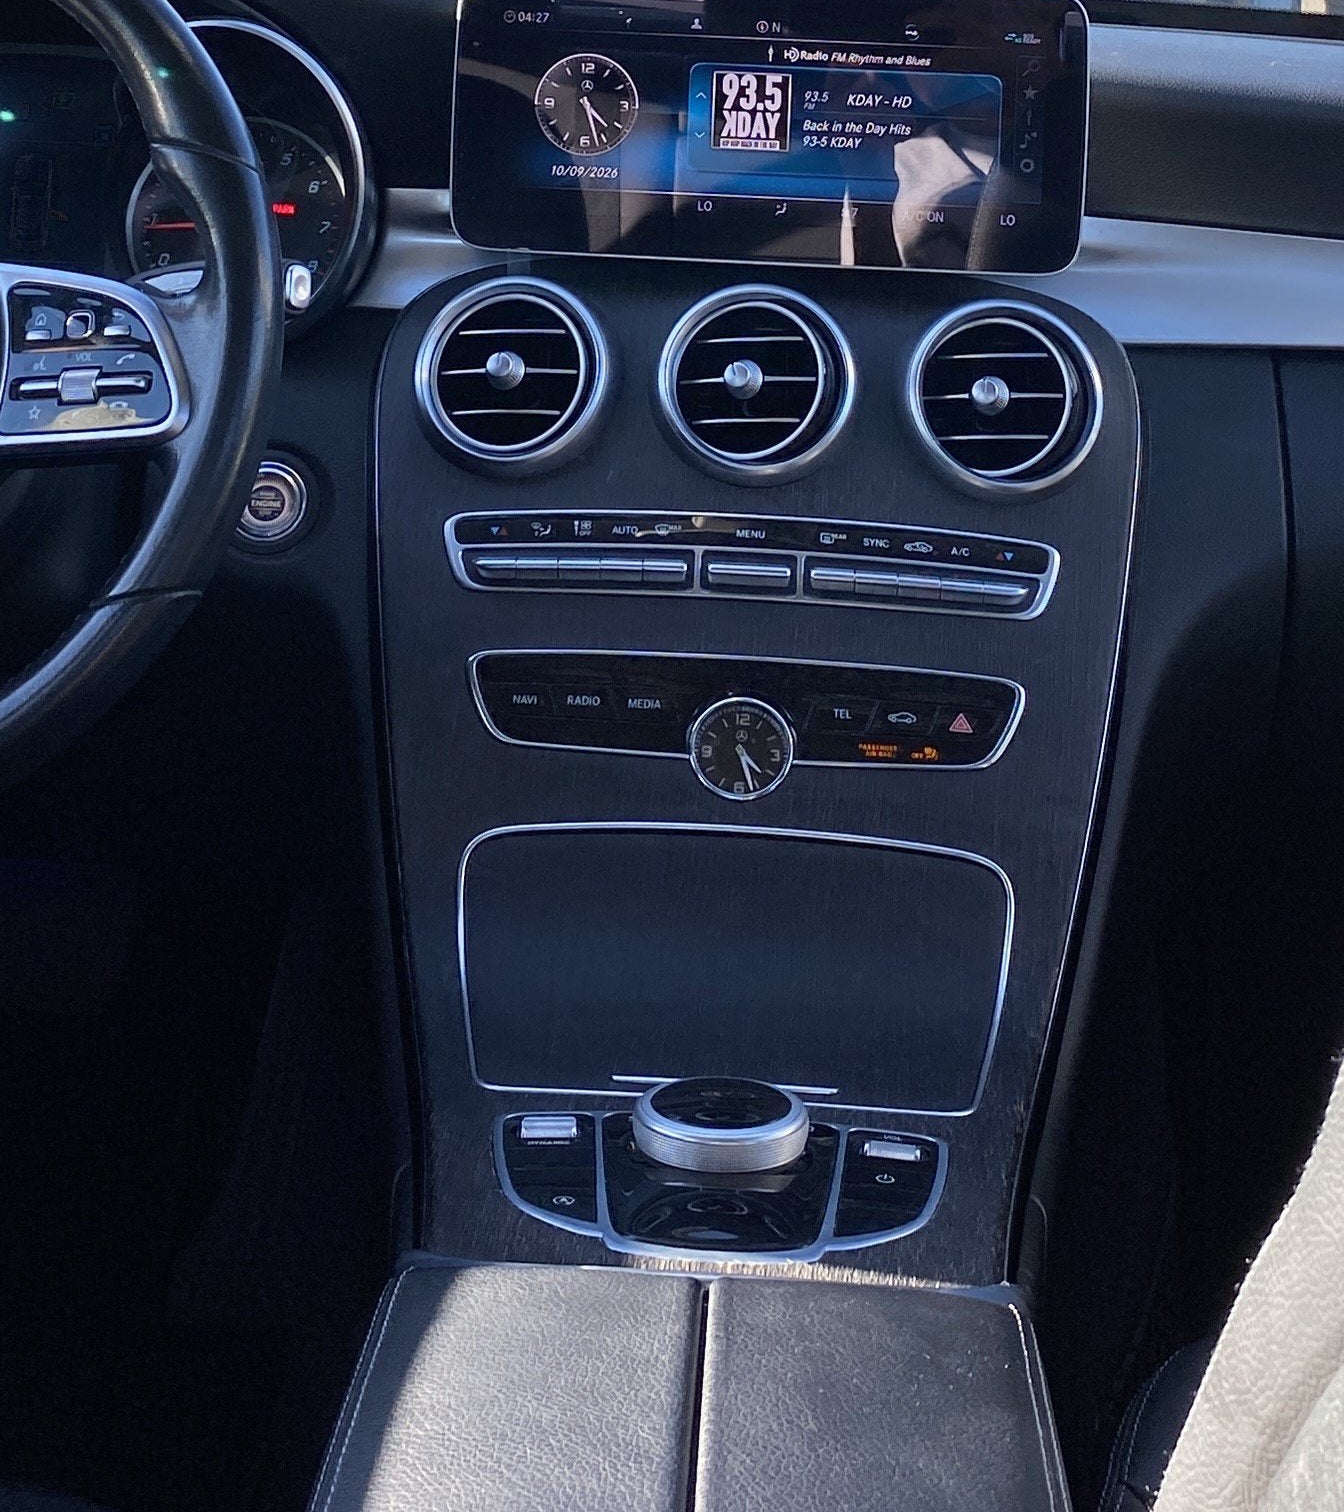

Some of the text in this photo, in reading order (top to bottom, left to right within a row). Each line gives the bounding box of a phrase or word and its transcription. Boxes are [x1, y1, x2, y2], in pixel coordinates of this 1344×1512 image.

[517, 11, 550, 23] 04:27
[772, 22, 781, 33] N
[800, 50, 828, 61] Radio
[831, 52, 846, 63] FM
[848, 51, 884, 66] Rhythm
[885, 55, 903, 65] and
[905, 55, 931, 66] Blues
[581, 63, 595, 74] 12
[722, 73, 782, 111] 93.5
[544, 98, 629, 112] 9 3
[805, 90, 828, 102] 93.5
[847, 94, 883, 107] KDAY
[891, 96, 912, 108] HD
[720, 110, 781, 139] KDAY
[803, 120, 911, 137] Back in the Day Hits
[580, 135, 590, 147] 6
[803, 137, 862, 149] 93-5 KDAY
[279, 153, 293, 166] 5
[551, 164, 618, 179] 10/09/2026
[308, 181, 321, 193] 6
[697, 200, 712, 212] LO
[927, 211, 944, 223] ON
[1000, 214, 1015, 226] LO
[318, 221, 331, 234] 7
[157, 253, 170, 266] 0
[612, 525, 639, 535] AUTO
[736, 529, 765, 539] MENU
[863, 537, 890, 548] SYNC
[950, 546, 970, 557] A/C
[513, 694, 537, 705] NAVI
[567, 695, 601, 707] RADIO
[627, 698, 662, 710] MEDIA
[833, 708, 852, 719] TEL
[735, 714, 750, 726] 12
[701, 745, 780, 762] 9 3
[734, 782, 745, 794] 6
